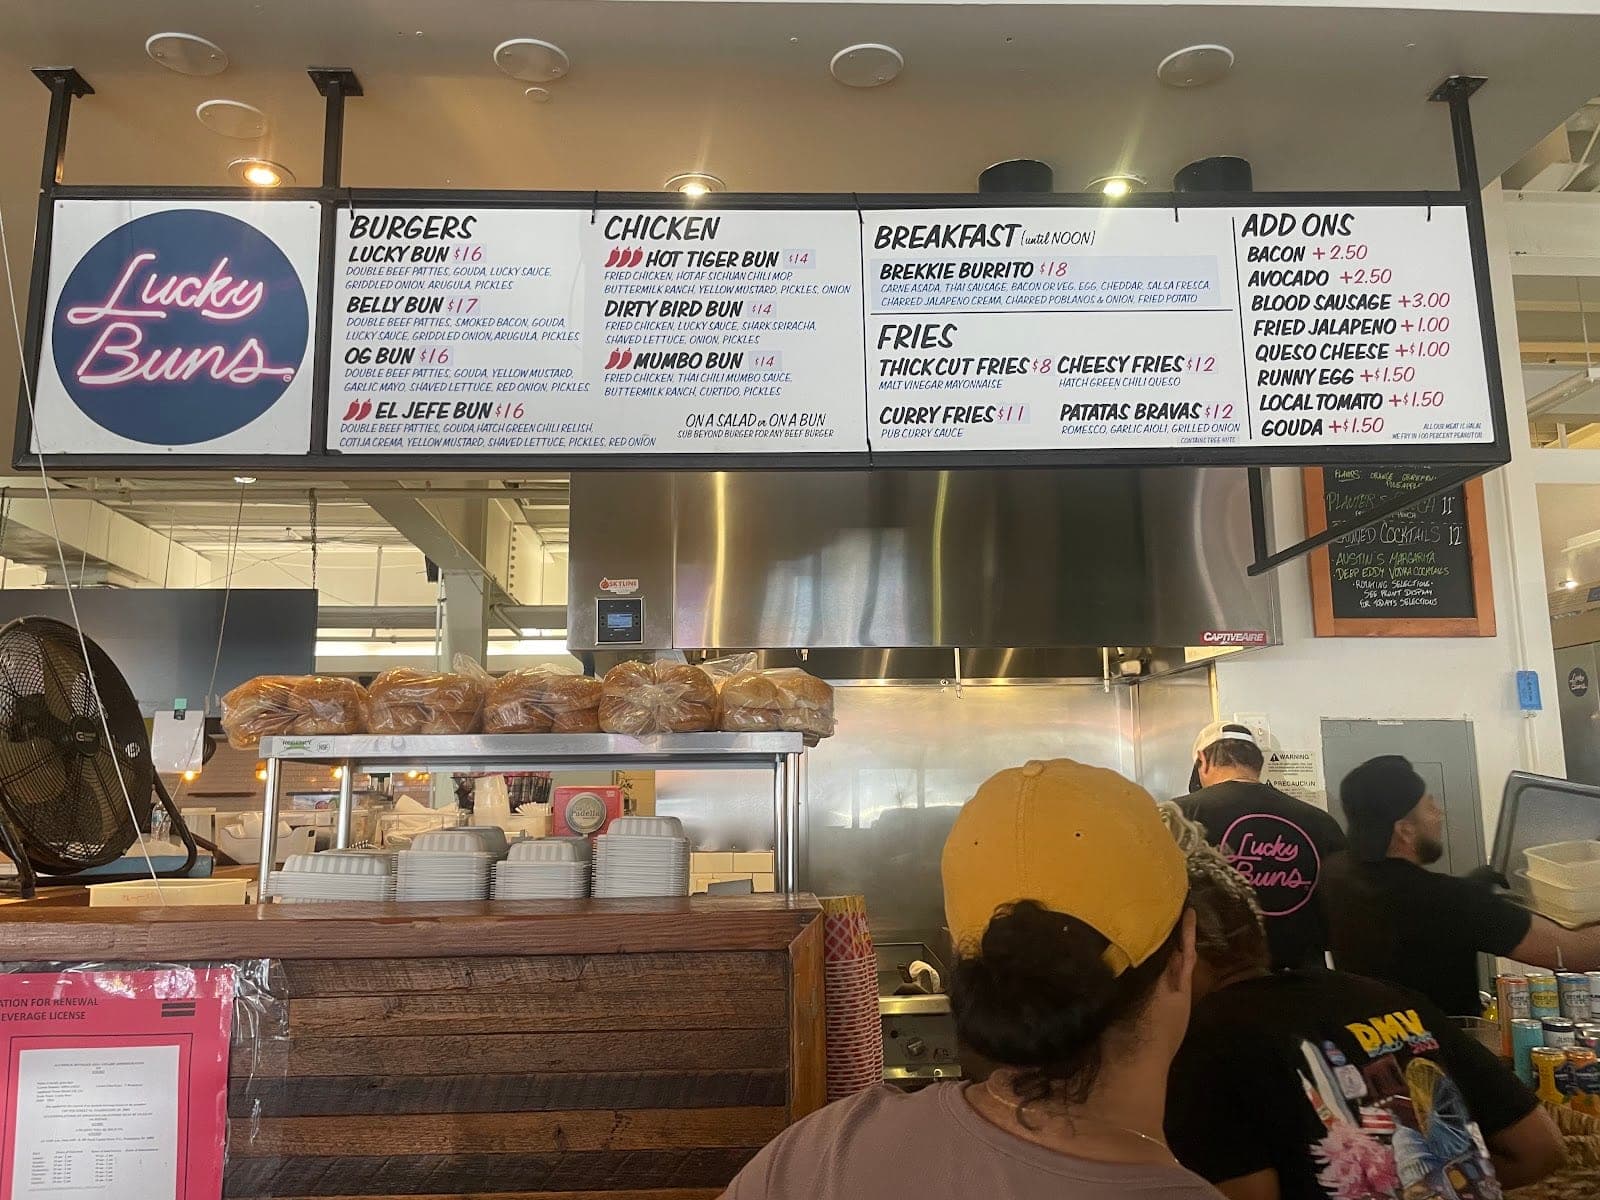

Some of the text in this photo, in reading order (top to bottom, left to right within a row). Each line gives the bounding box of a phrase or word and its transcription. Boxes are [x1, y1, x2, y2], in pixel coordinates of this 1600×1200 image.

[349, 214, 478, 241] BURGERS
[604, 215, 721, 241] CHICKEN
[1241, 213, 1355, 238] ADD ONS
[874, 224, 1022, 249] BREAKFAST
[349, 245, 483, 262] LUCKY BUN $16
[646, 250, 809, 268] HOT TIGER BUN $14
[1247, 246, 1306, 263] BACON
[604, 271, 632, 281] FRIED
[676, 271, 692, 281] HOT
[692, 271, 706, 281] AF
[708, 271, 746, 281] SICHUAN
[747, 271, 771, 281] CHILI
[880, 261, 1067, 281] BREKKIE BURRITO $18
[1247, 268, 1392, 287] AVOCADO +2.50
[67, 253, 264, 325] Lucky
[604, 284, 664, 294] BUTTERMILK
[699, 284, 735, 294] YELLOW
[822, 285, 851, 294] ONION
[346, 296, 479, 314] BELLY BUN $17
[604, 300, 773, 318] DIRTY BIRD BUN $14
[1251, 292, 1451, 312] BLOOD SAUSAGE +3.00
[877, 323, 958, 350] FRIES
[1253, 317, 1450, 337] FRIED JALAPENO +1.00
[605, 335, 641, 345] SHAVED
[723, 335, 760, 345] PICKLES
[77, 321, 295, 385] Buns
[344, 347, 449, 364] OG BUN $16
[1255, 341, 1451, 361] QUESO CHEESE +$1.00
[633, 352, 775, 370] MUMBO BUN $14
[880, 356, 1052, 377] THICK CUT FRIES $8
[1057, 355, 1215, 374] CHEESY FRIES $12
[878, 379, 1003, 390] MALT VINEGAR MAYONNAISE
[1059, 377, 1182, 388] HATCH GREEN CHILI QUESO
[1257, 366, 1416, 386] RUNNY EGG +$1.50
[343, 382, 378, 392] GARLIC
[409, 382, 446, 392] SHAVED
[496, 382, 515, 392] RED
[551, 382, 590, 392] PICKLES
[375, 402, 525, 419] EL JEFE BUN $16
[1259, 391, 1445, 411] LOCAL TOMATO +$1.50
[685, 413, 826, 427] ON A SALAD or ON A BUN
[879, 405, 1024, 425] CURRY FRIES $11
[1060, 402, 1233, 422] PATATAS BRAVAS $12
[881, 427, 964, 439] PUB CURRY SAUCE
[1261, 417, 1384, 436] GOUDA +$1.50
[1380, 521, 1440, 544] COCKTAILS
[1226, 833, 1298, 862] Lucky
[31, 998, 51, 1007] FOR
[53, 997, 99, 1006] RENEWAL
[50, 1011, 86, 1020] LICENSE
[1344, 1009, 1425, 1052] DMV
